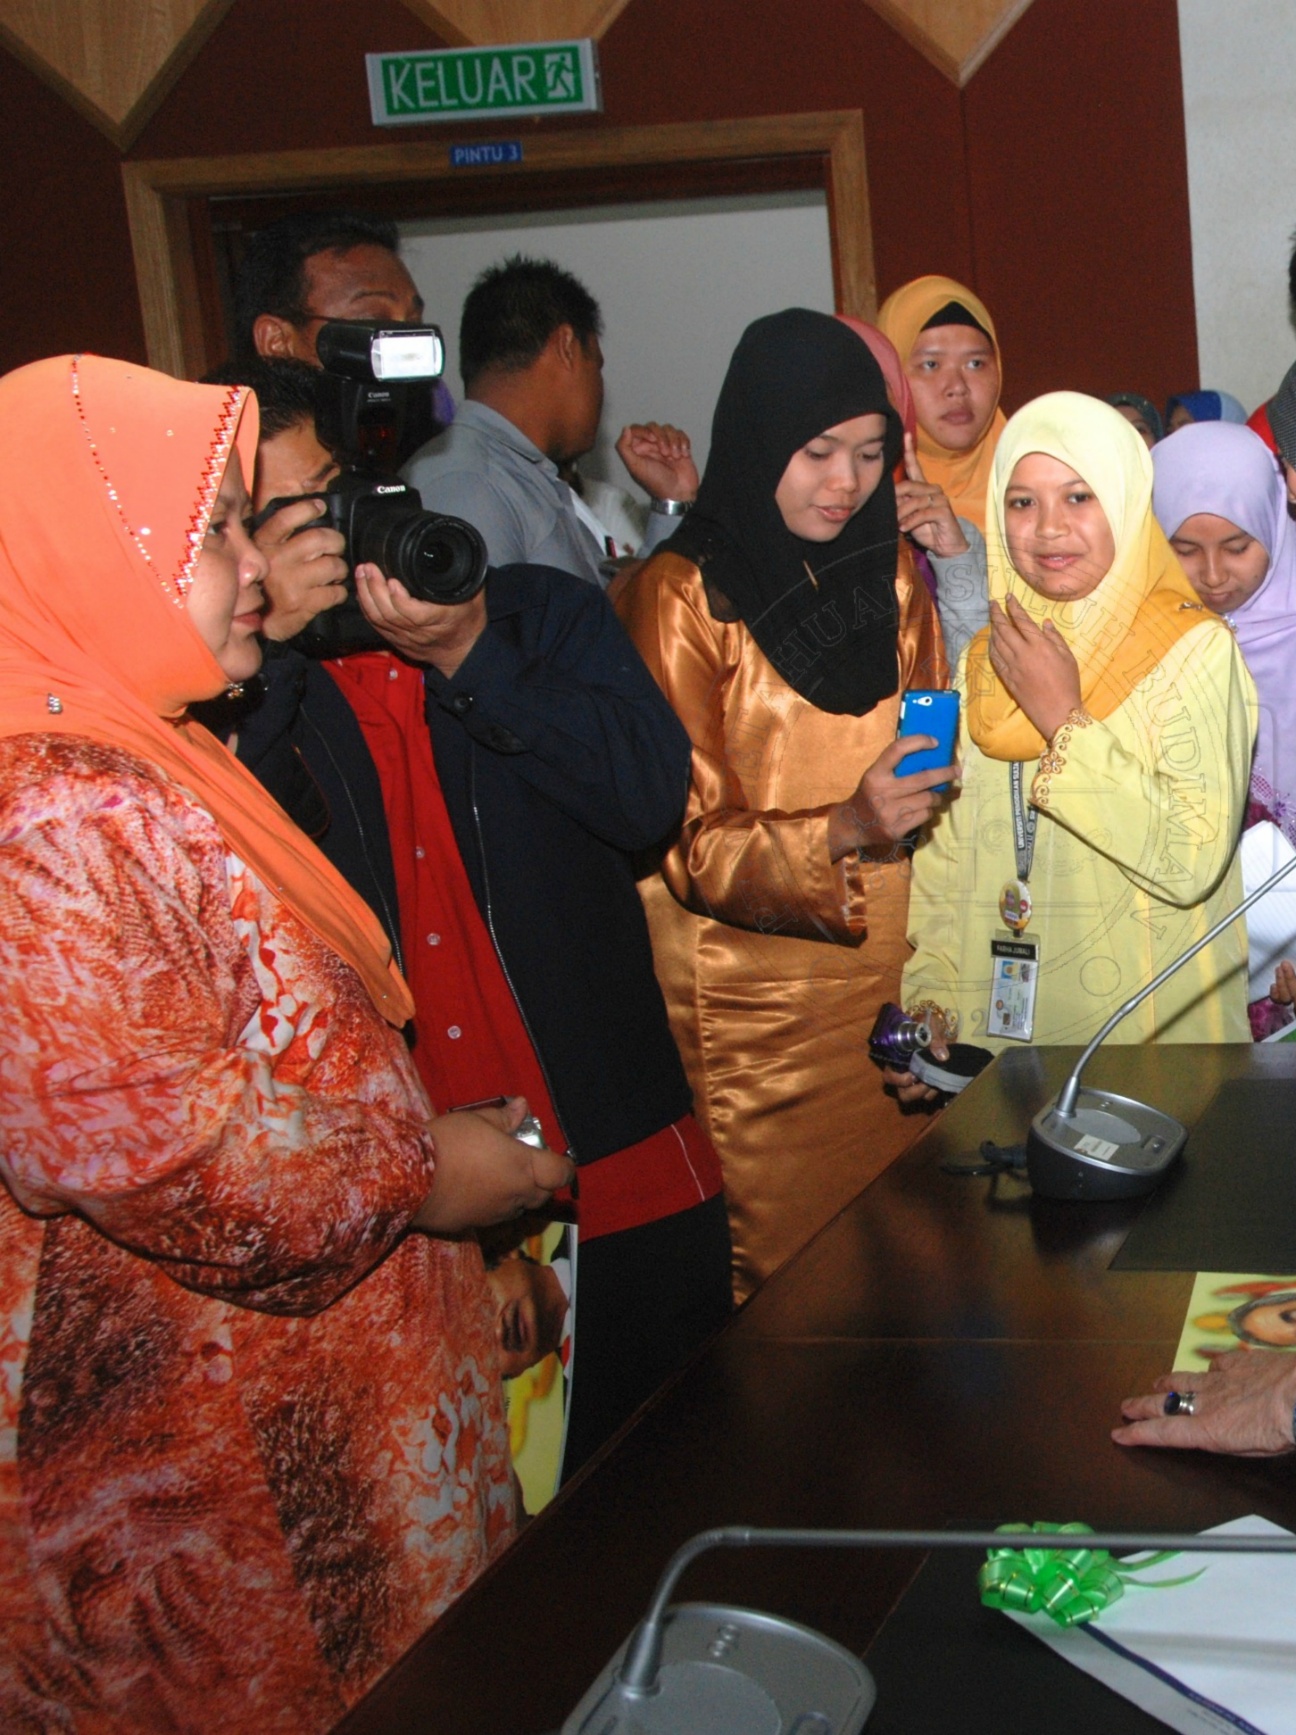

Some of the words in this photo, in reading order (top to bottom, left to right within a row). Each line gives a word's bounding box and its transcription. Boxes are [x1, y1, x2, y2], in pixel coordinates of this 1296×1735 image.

[388, 55, 537, 110] KELUAR
[454, 145, 503, 163] PINTU
[508, 144, 518, 160] 3
[376, 485, 406, 494] Canon
